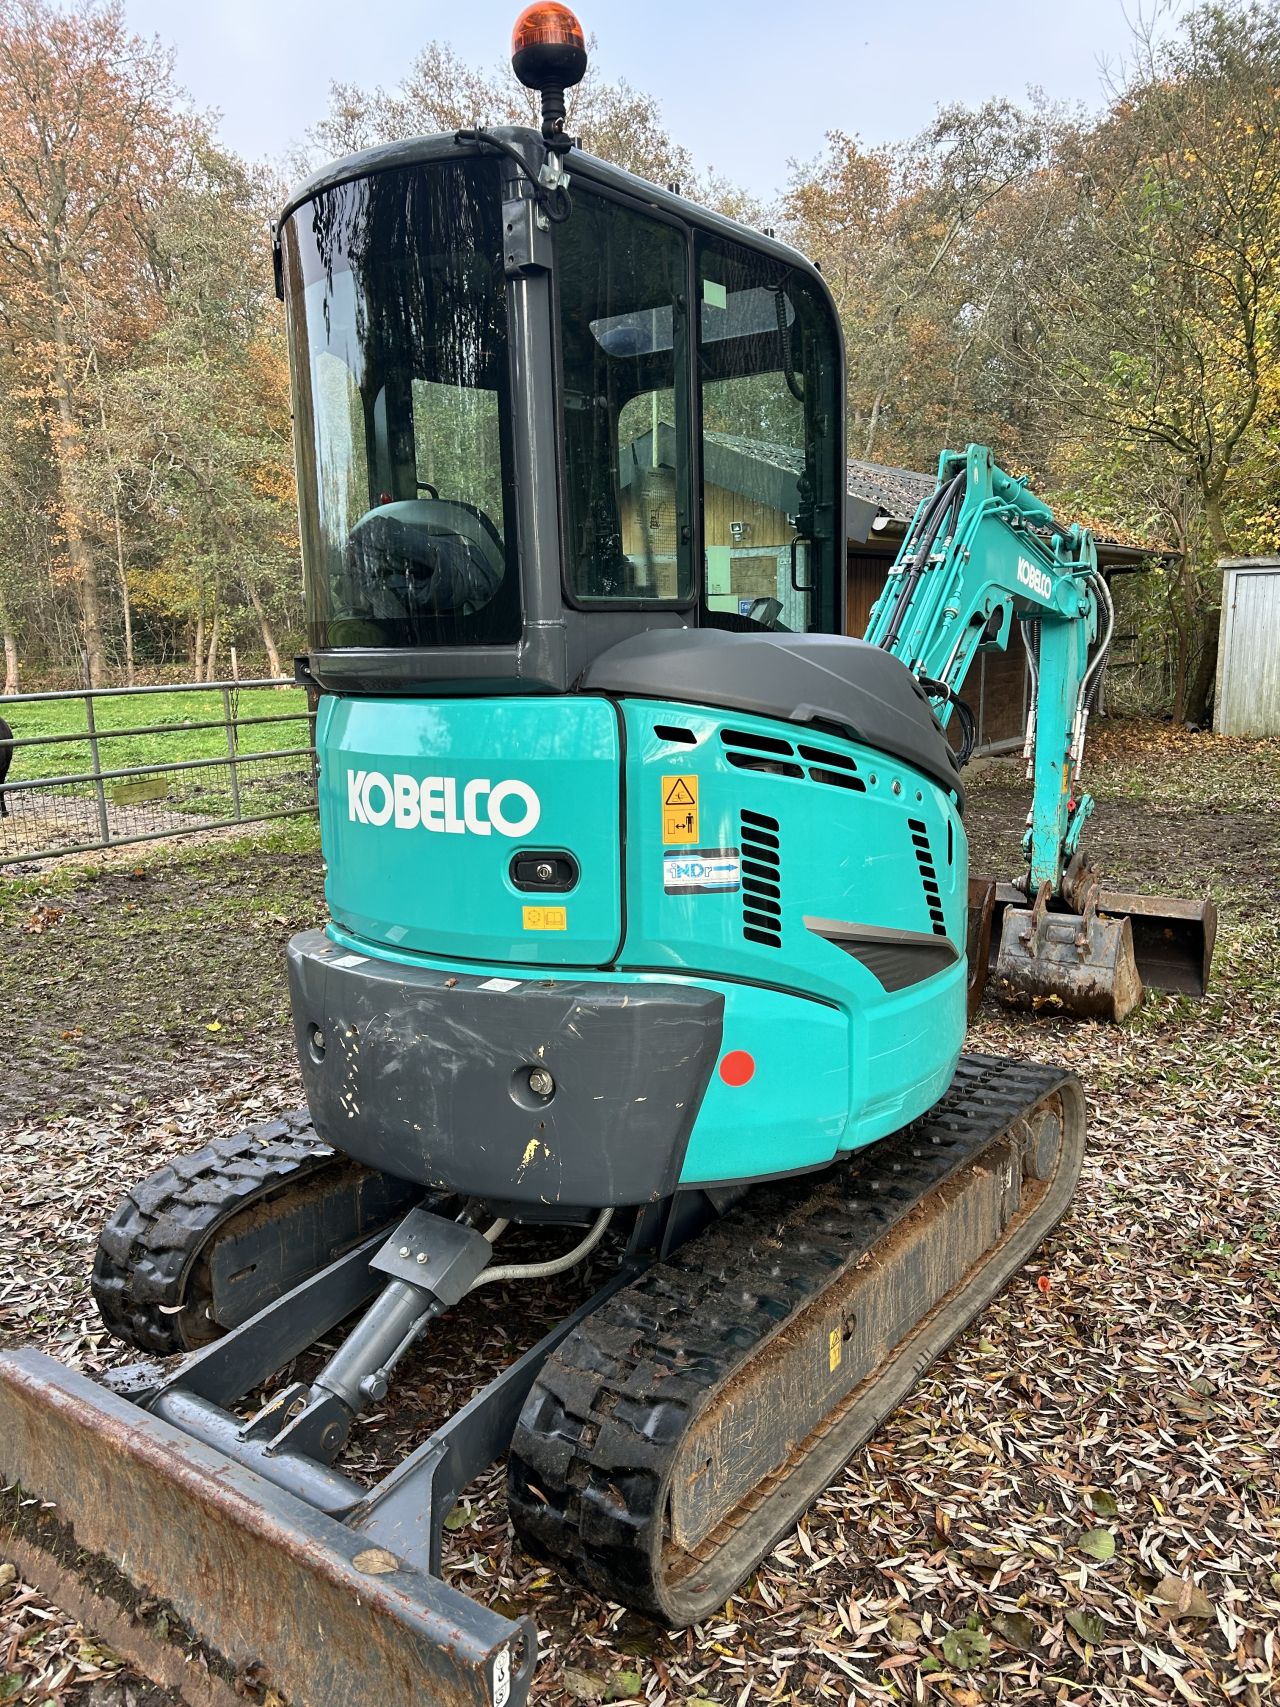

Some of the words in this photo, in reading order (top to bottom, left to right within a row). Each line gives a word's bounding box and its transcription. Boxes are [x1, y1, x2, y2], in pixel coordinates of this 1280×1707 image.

[1018, 556, 1051, 599] KOBELCO
[347, 769, 541, 837] KOBELCO
[670, 862, 713, 879] iNDr
